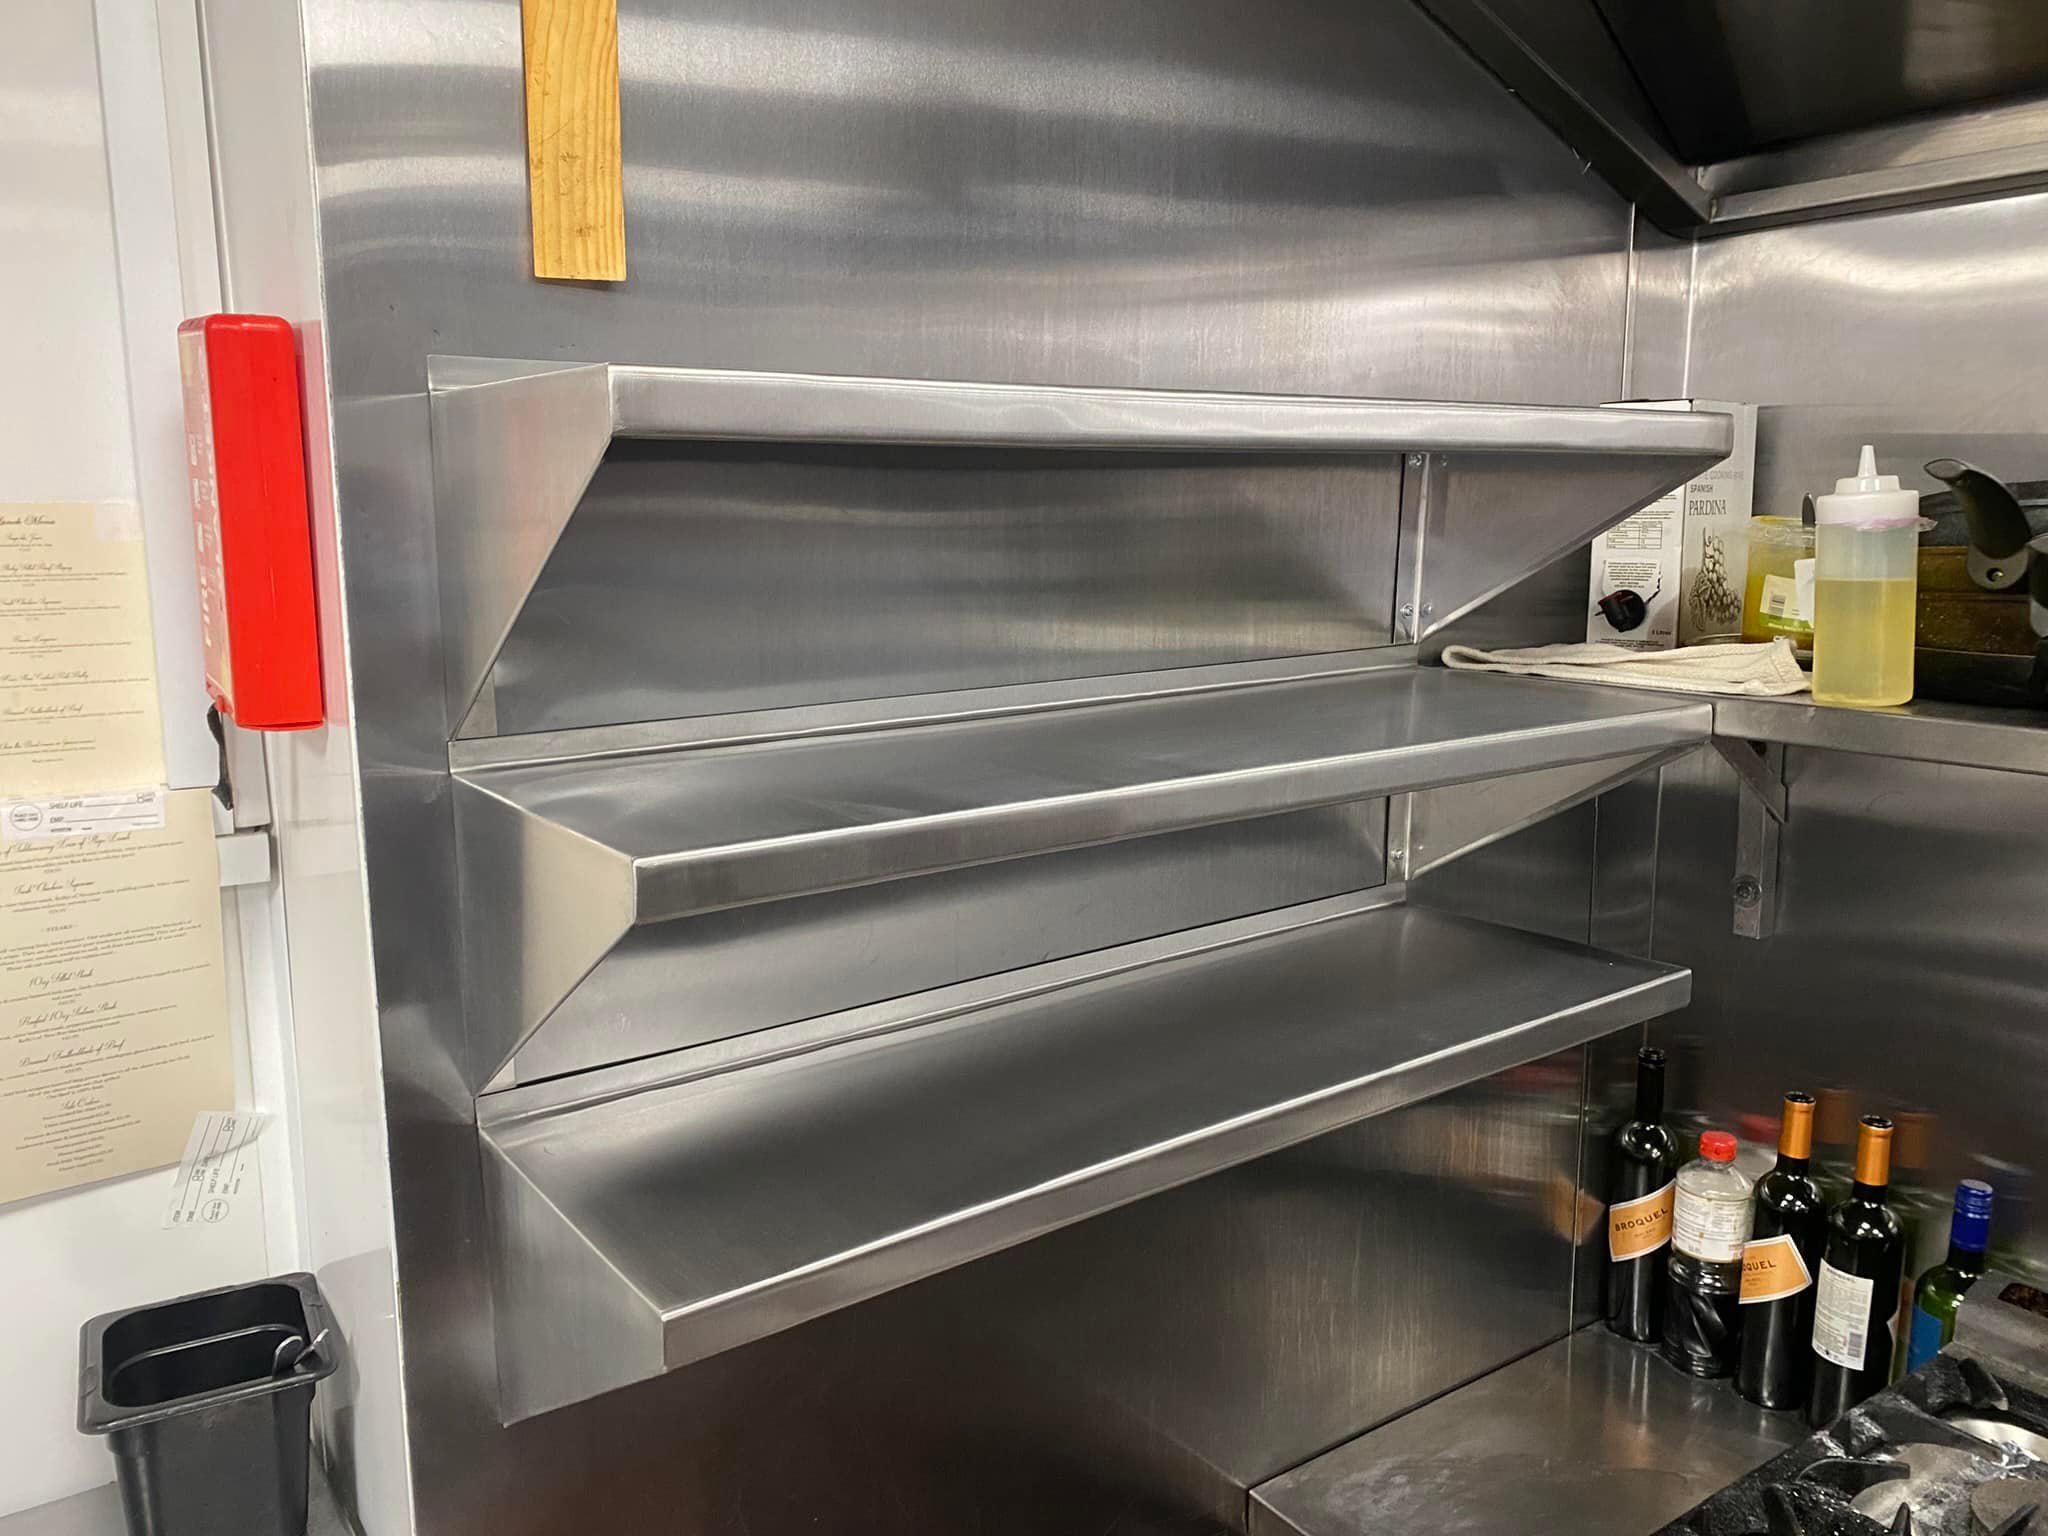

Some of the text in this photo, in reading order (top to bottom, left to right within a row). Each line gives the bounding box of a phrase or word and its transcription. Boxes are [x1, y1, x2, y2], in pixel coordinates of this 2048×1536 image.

[1690, 484, 1713, 493] SPANISH
[1689, 499, 1727, 516] PARDINA
[1614, 1207, 1669, 1232] BROQUEL
